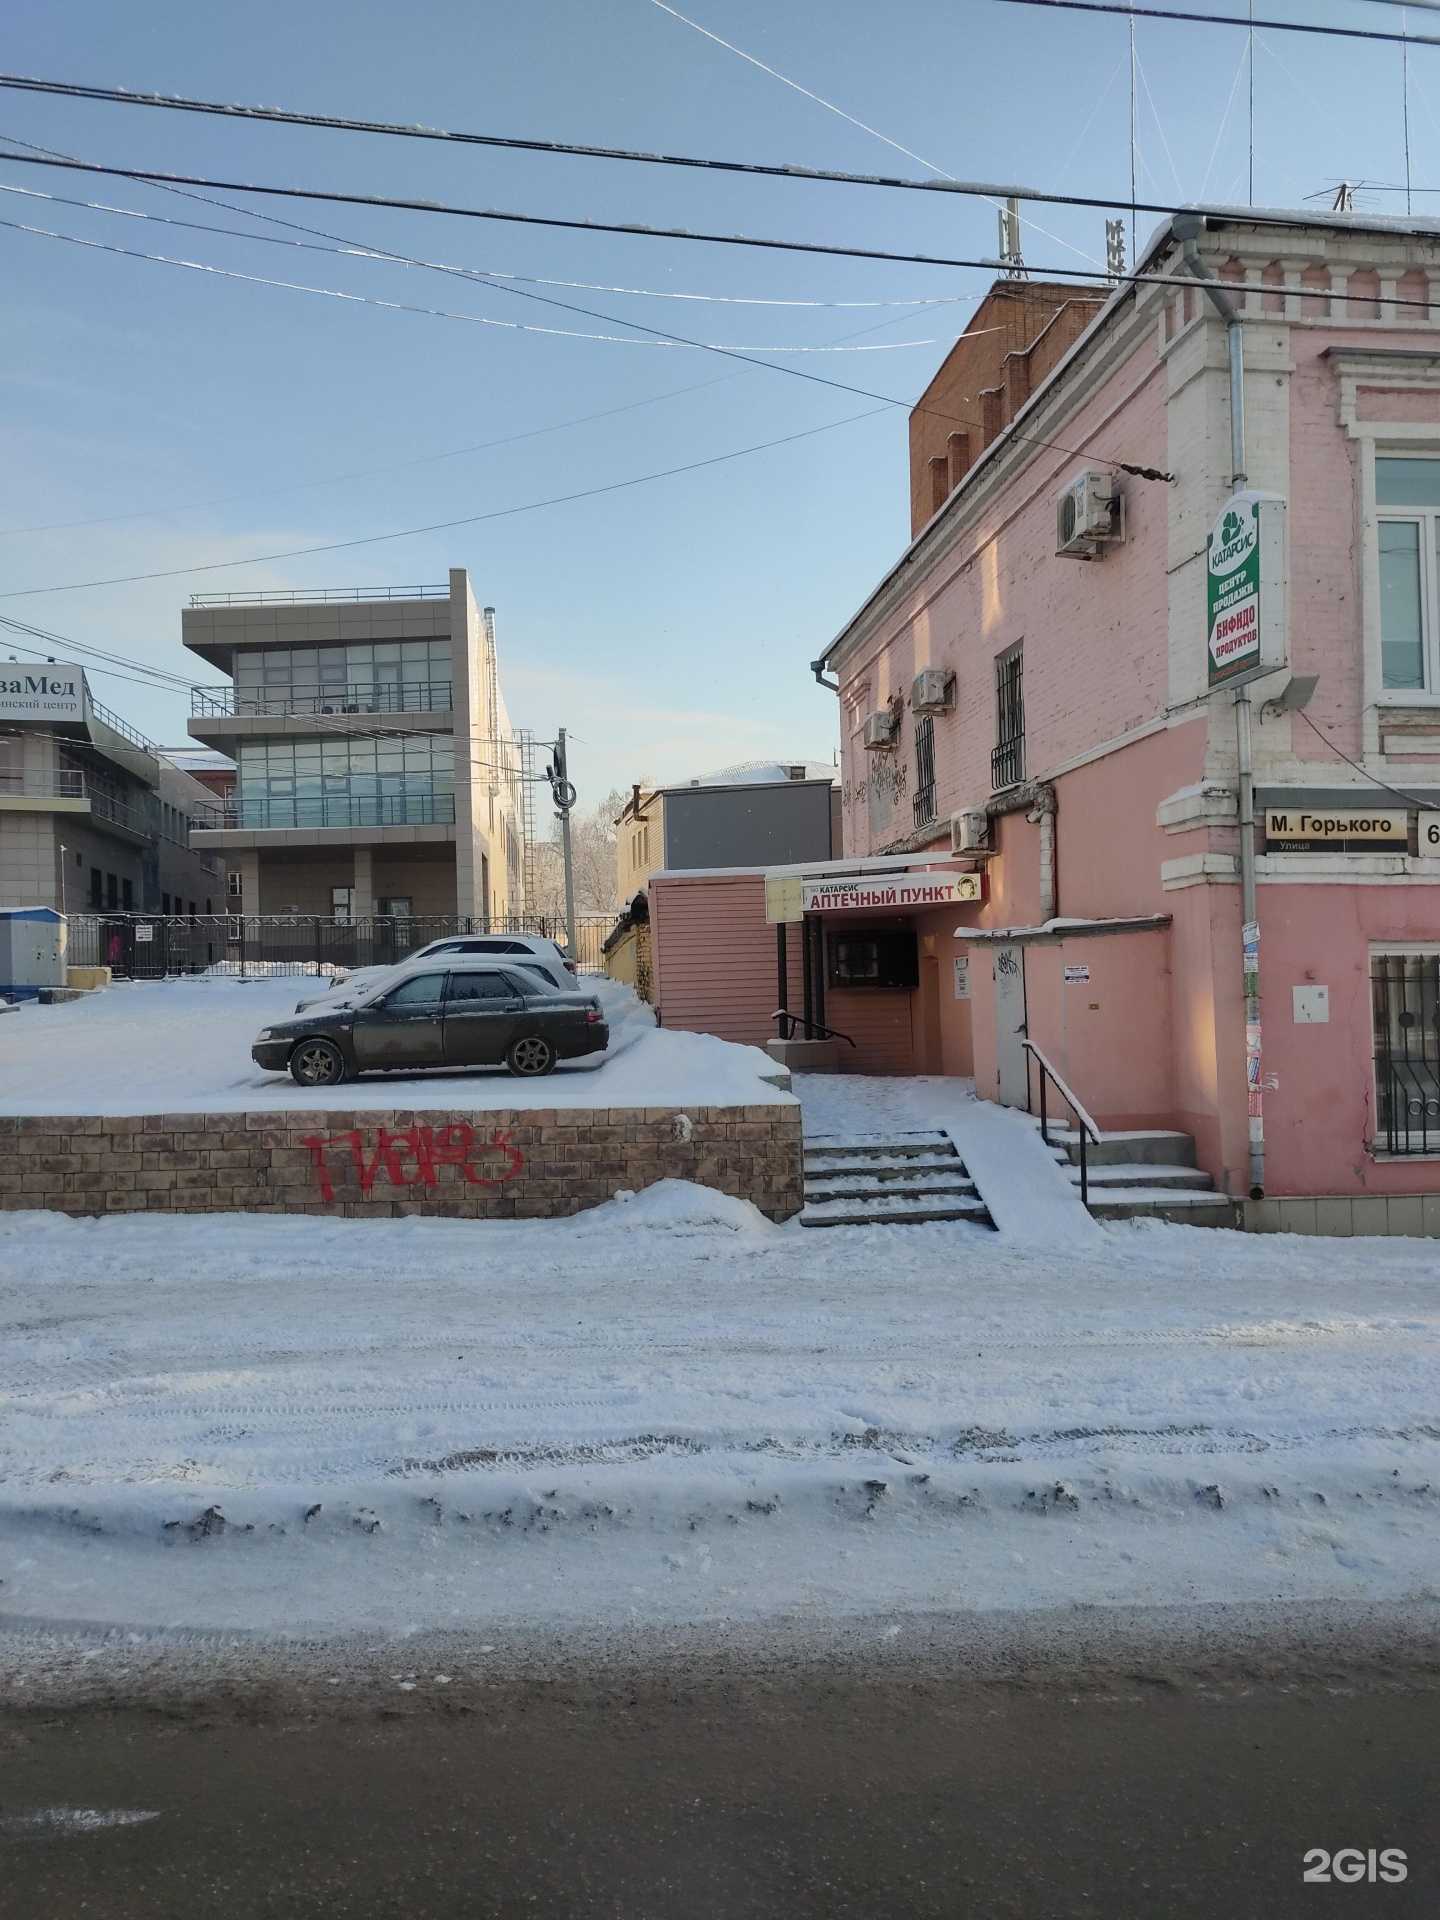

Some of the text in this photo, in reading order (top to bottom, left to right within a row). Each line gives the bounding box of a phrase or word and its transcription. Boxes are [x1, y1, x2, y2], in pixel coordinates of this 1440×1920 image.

[1212, 532, 1253, 569] КАТАРСИС
[1219, 570, 1247, 595] ЦЕНТР
[1213, 582, 1253, 613] ПРОДАЖИ
[1216, 605, 1255, 640] БИФИДО
[1216, 629, 1257, 658] ПРОДУКТОВ
[43, 702, 77, 712] центр
[1271, 815, 1392, 835] М. Горького
[1280, 841, 1310, 850] Улица
[810, 885, 954, 909] АПТЕЧНЫЙ ПУНКТ
[819, 884, 859, 893] КАТАРСИС
